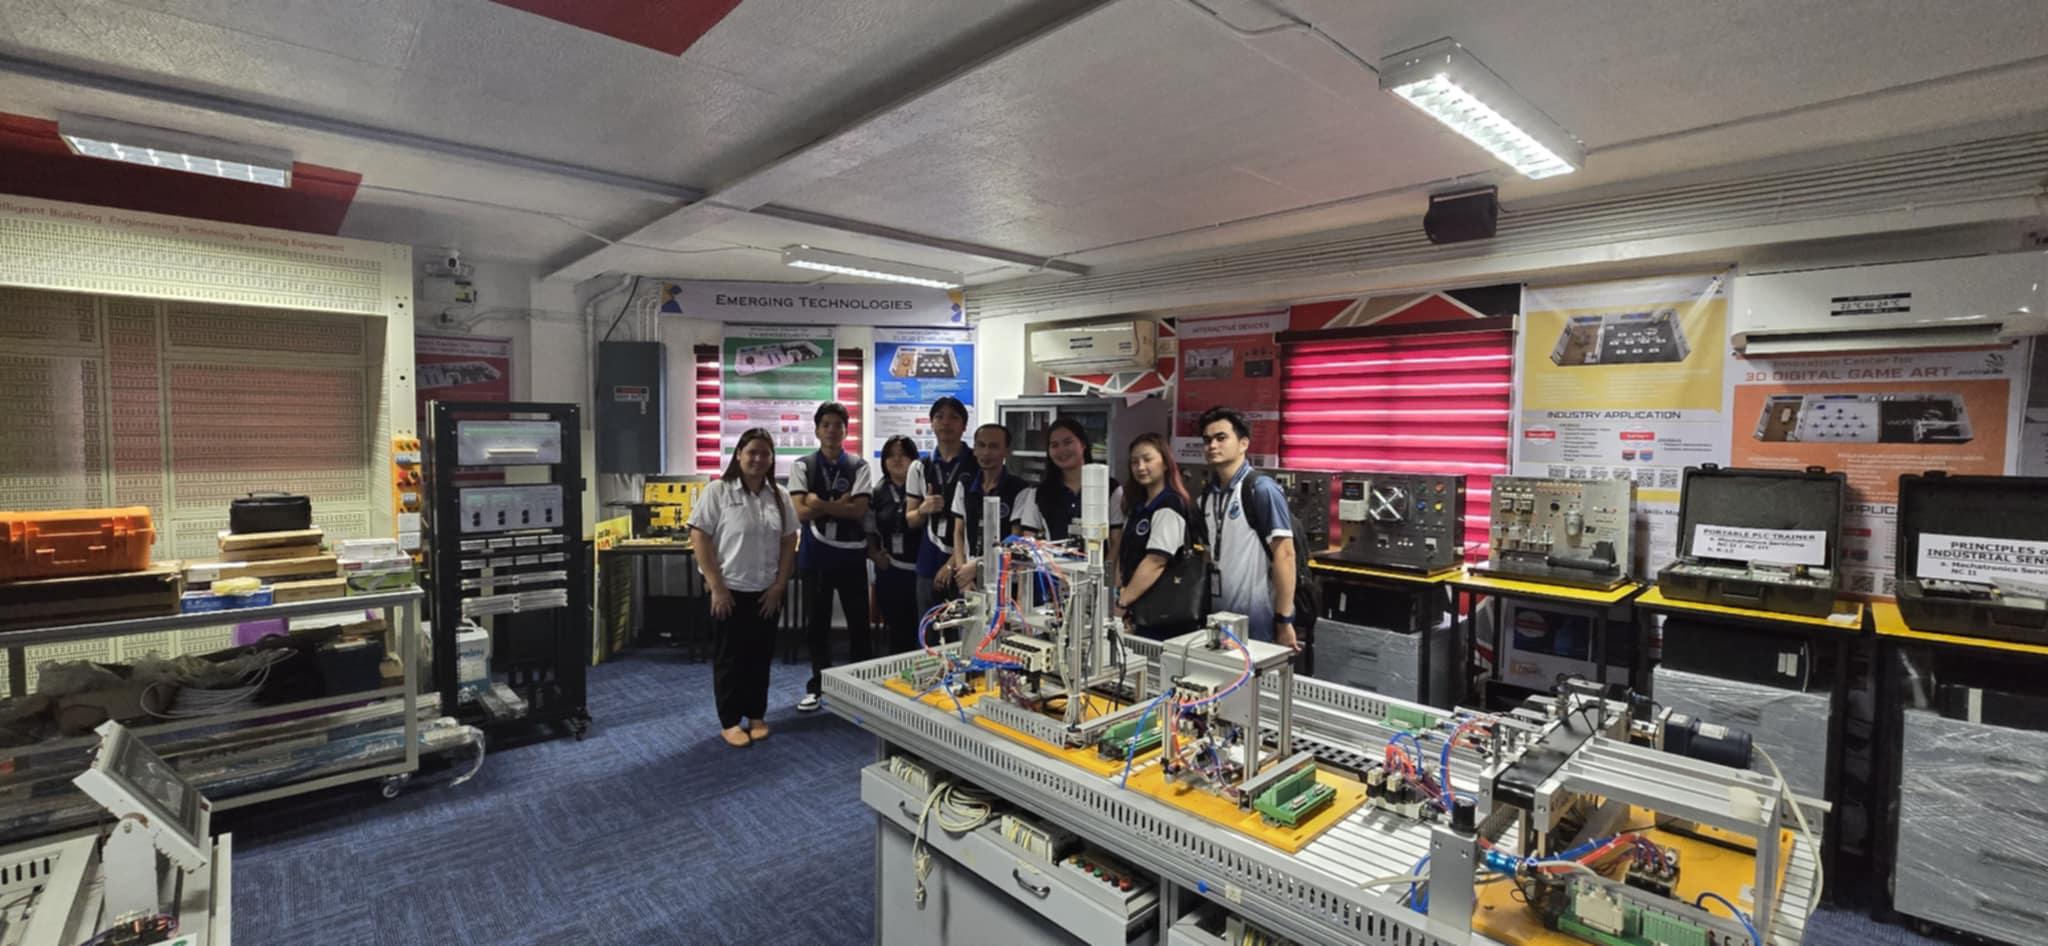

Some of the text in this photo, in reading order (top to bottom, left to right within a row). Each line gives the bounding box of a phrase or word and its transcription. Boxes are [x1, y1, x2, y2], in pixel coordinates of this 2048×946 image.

[49, 207, 102, 224] Building
[109, 215, 179, 233] Engineering
[716, 294, 913, 310] EMERGING TECHNOLOGIES
[1192, 321, 1269, 333] INTERACTIVE DEVICES
[1774, 355, 1912, 368] Innovation Center for
[1745, 366, 1952, 382] 3D DIGITAL GAME ART
[1547, 411, 1682, 420] INDUSTRY APPLICATION
[1703, 529, 1749, 537] PORTABLE
[1951, 542, 2034, 554] PRINCIPLES
[1928, 549, 2011, 562] INDUSTRIAL
[1952, 562, 2018, 572] Mechatronics
